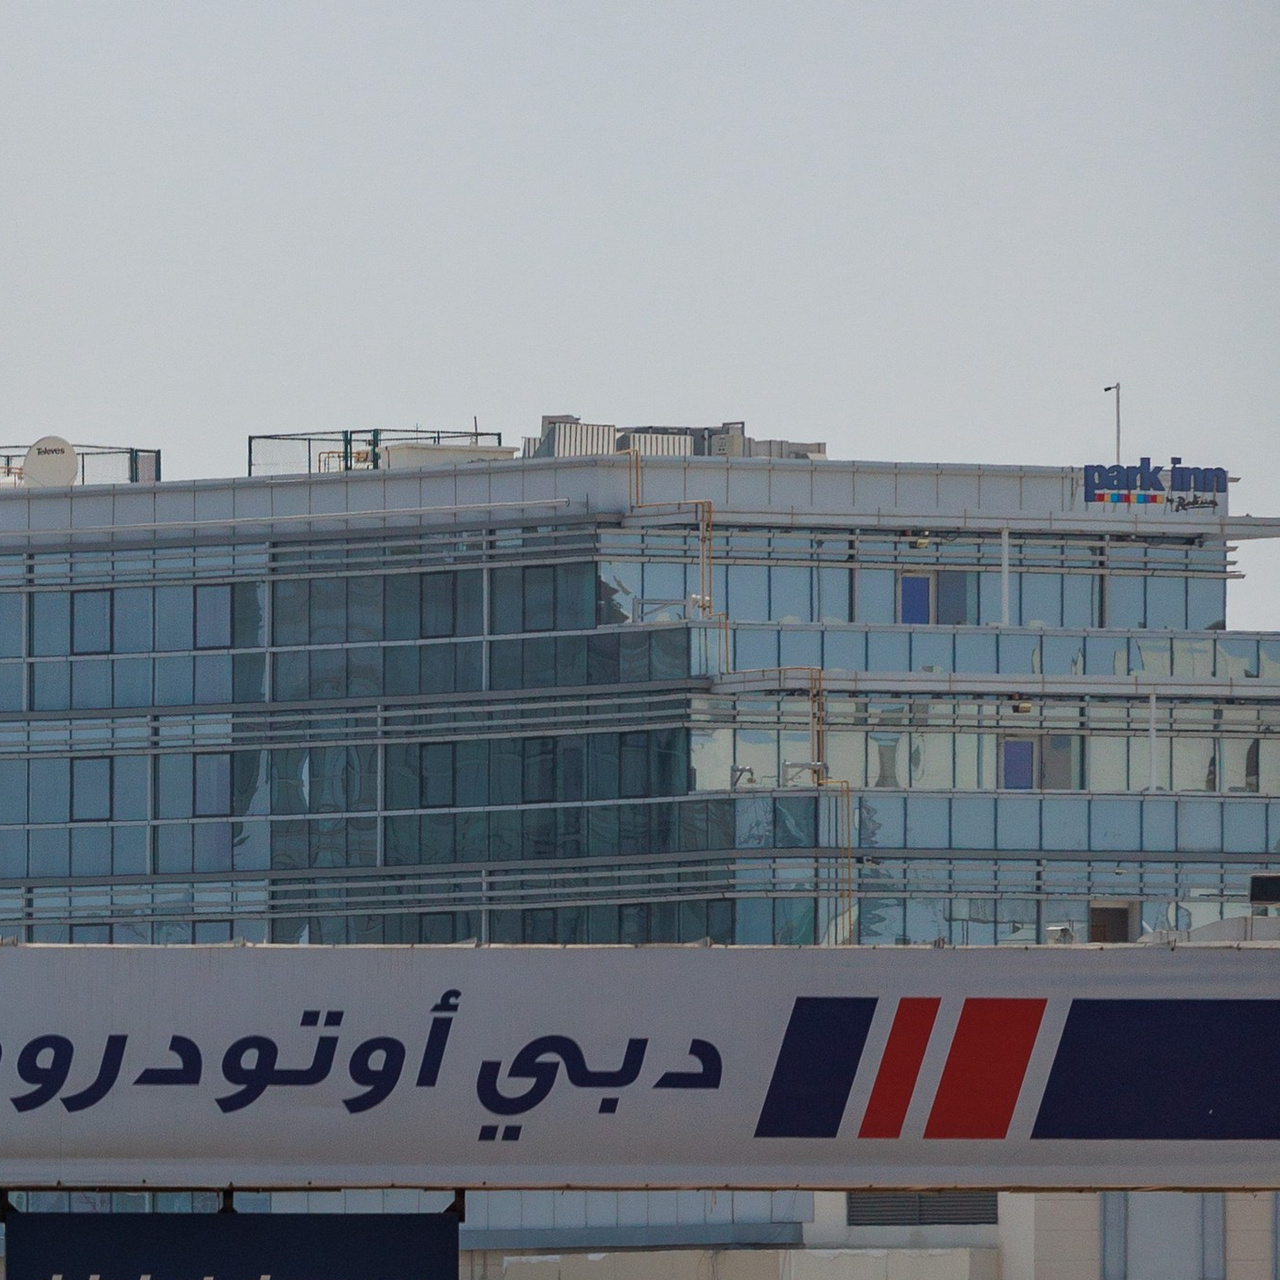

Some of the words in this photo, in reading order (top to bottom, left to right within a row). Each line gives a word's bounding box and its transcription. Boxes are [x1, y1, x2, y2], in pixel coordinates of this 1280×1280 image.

[36, 446, 65, 456] Televes
[1084, 457, 1165, 502] park
[1171, 457, 1227, 493] inn
[477, 1033, 722, 1141] دبي
